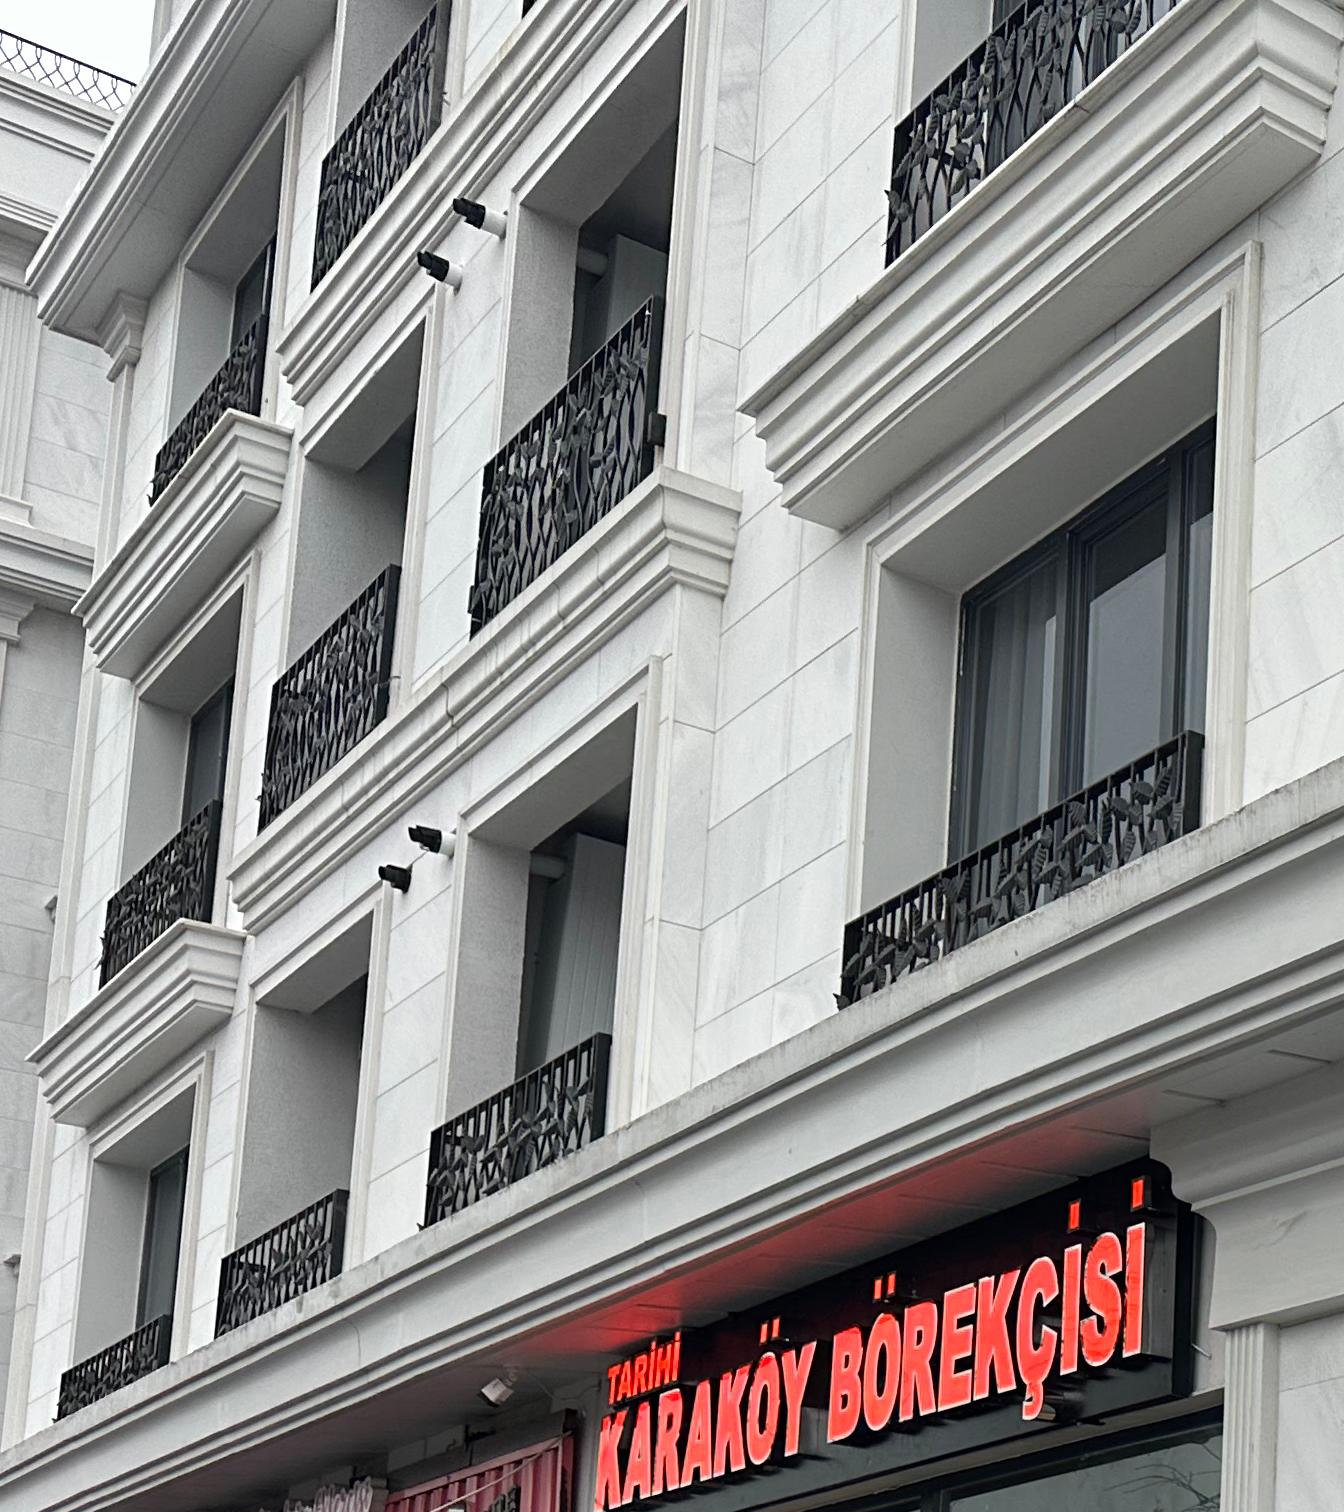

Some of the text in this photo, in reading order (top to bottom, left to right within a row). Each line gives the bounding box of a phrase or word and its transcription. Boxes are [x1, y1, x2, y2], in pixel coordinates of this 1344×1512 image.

[594, 1177, 1146, 1512] KARAKÖY BÖREKÇİSİ
[607, 1331, 681, 1403] TARİHİ
